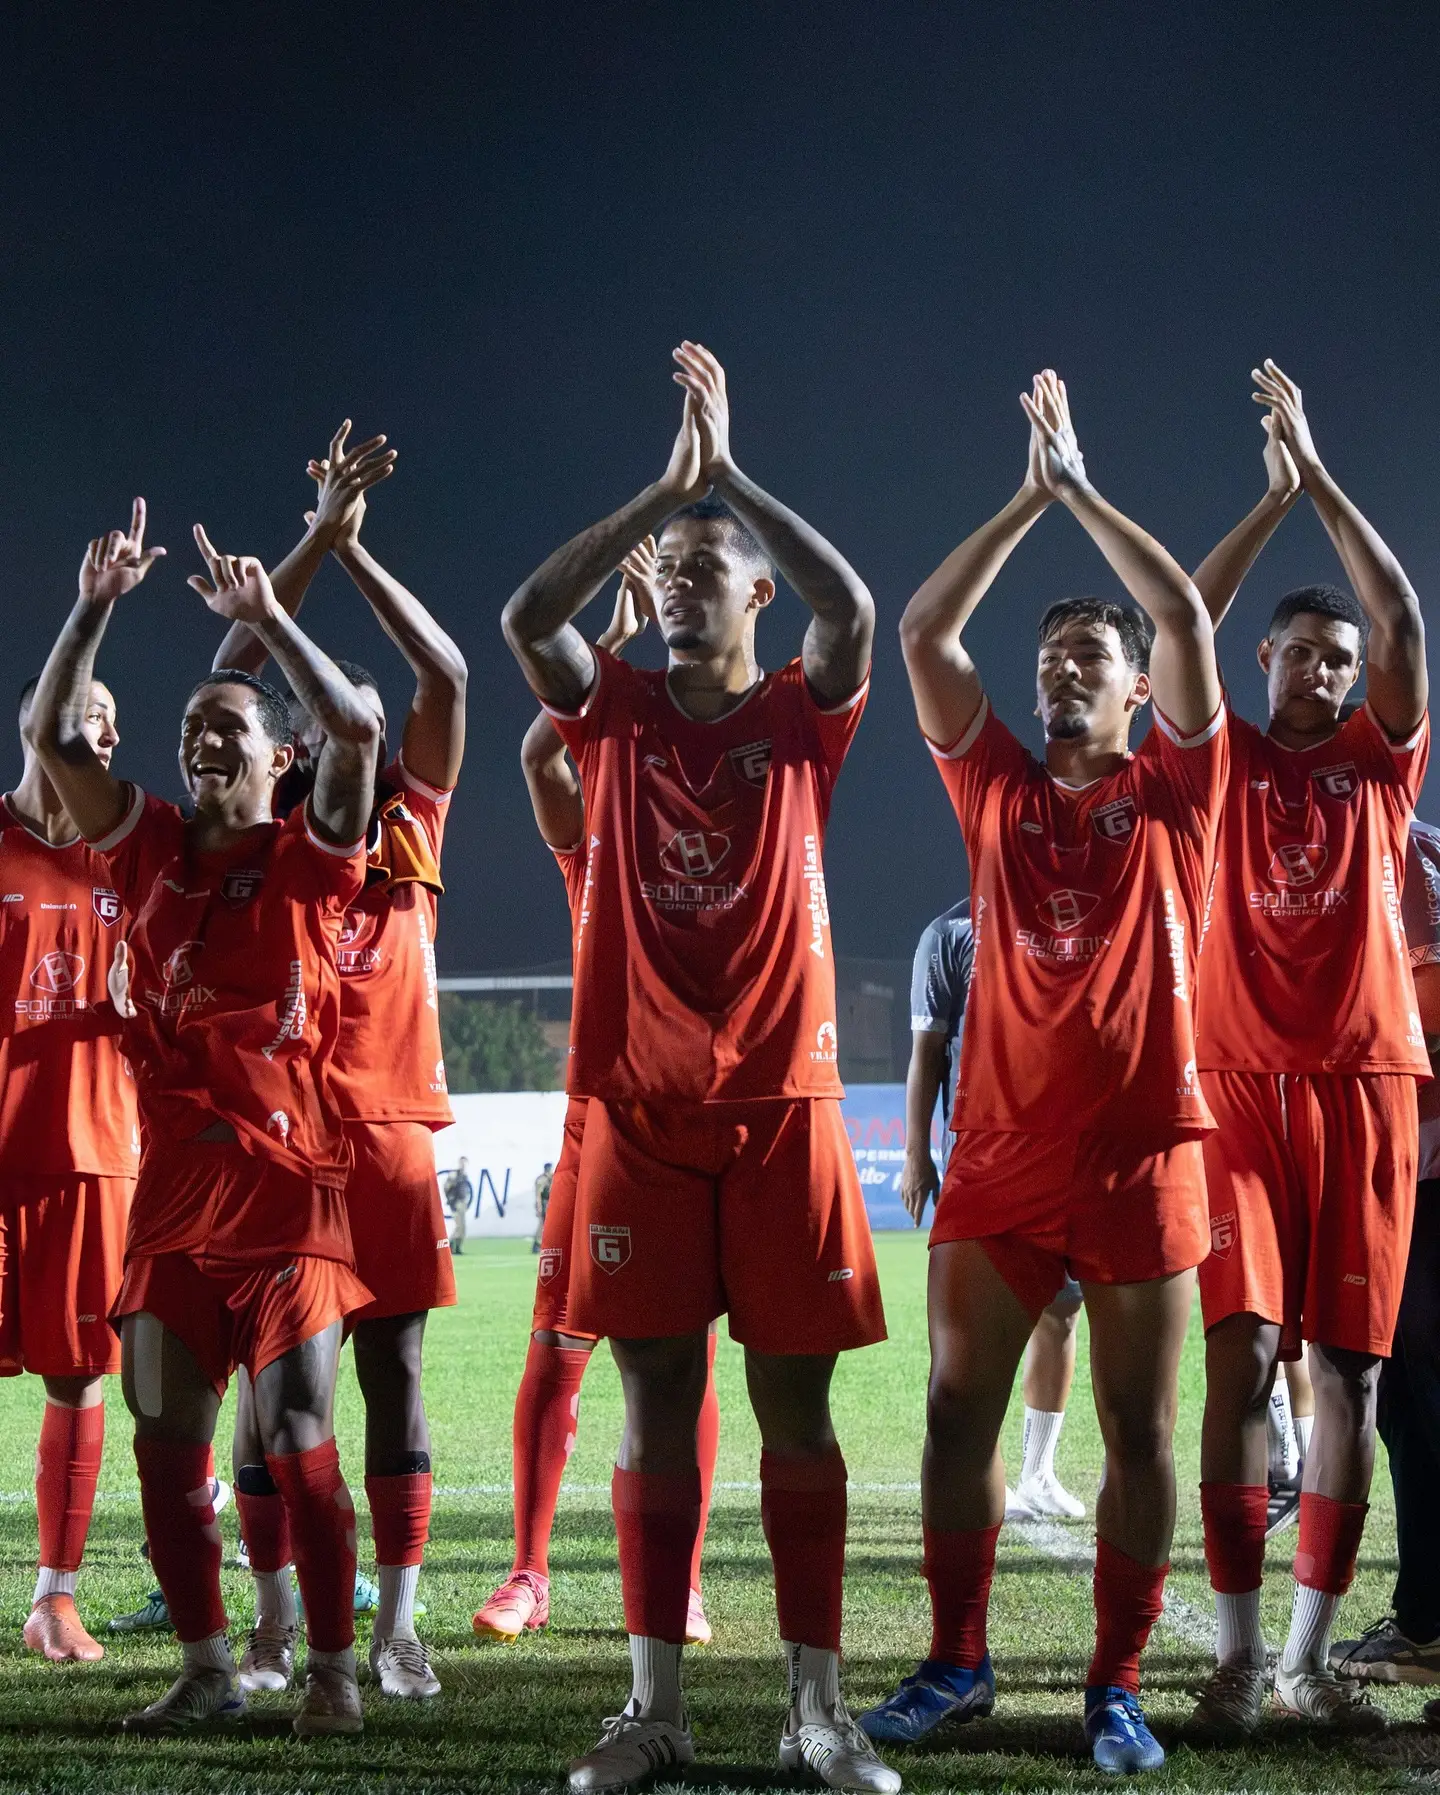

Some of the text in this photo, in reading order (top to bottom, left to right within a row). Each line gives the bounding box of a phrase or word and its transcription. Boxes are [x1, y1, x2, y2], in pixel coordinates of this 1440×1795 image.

[1326, 773, 1351, 794] G
[1104, 811, 1131, 837] G
[641, 880, 748, 902] solomix
[803, 835, 825, 959] Australian
[1249, 888, 1350, 908] solomix
[101, 897, 118, 918] G
[261, 960, 302, 1061] Australian
[1212, 1225, 1232, 1251] G
[599, 1239, 620, 1262] G
[540, 1259, 554, 1277] G
